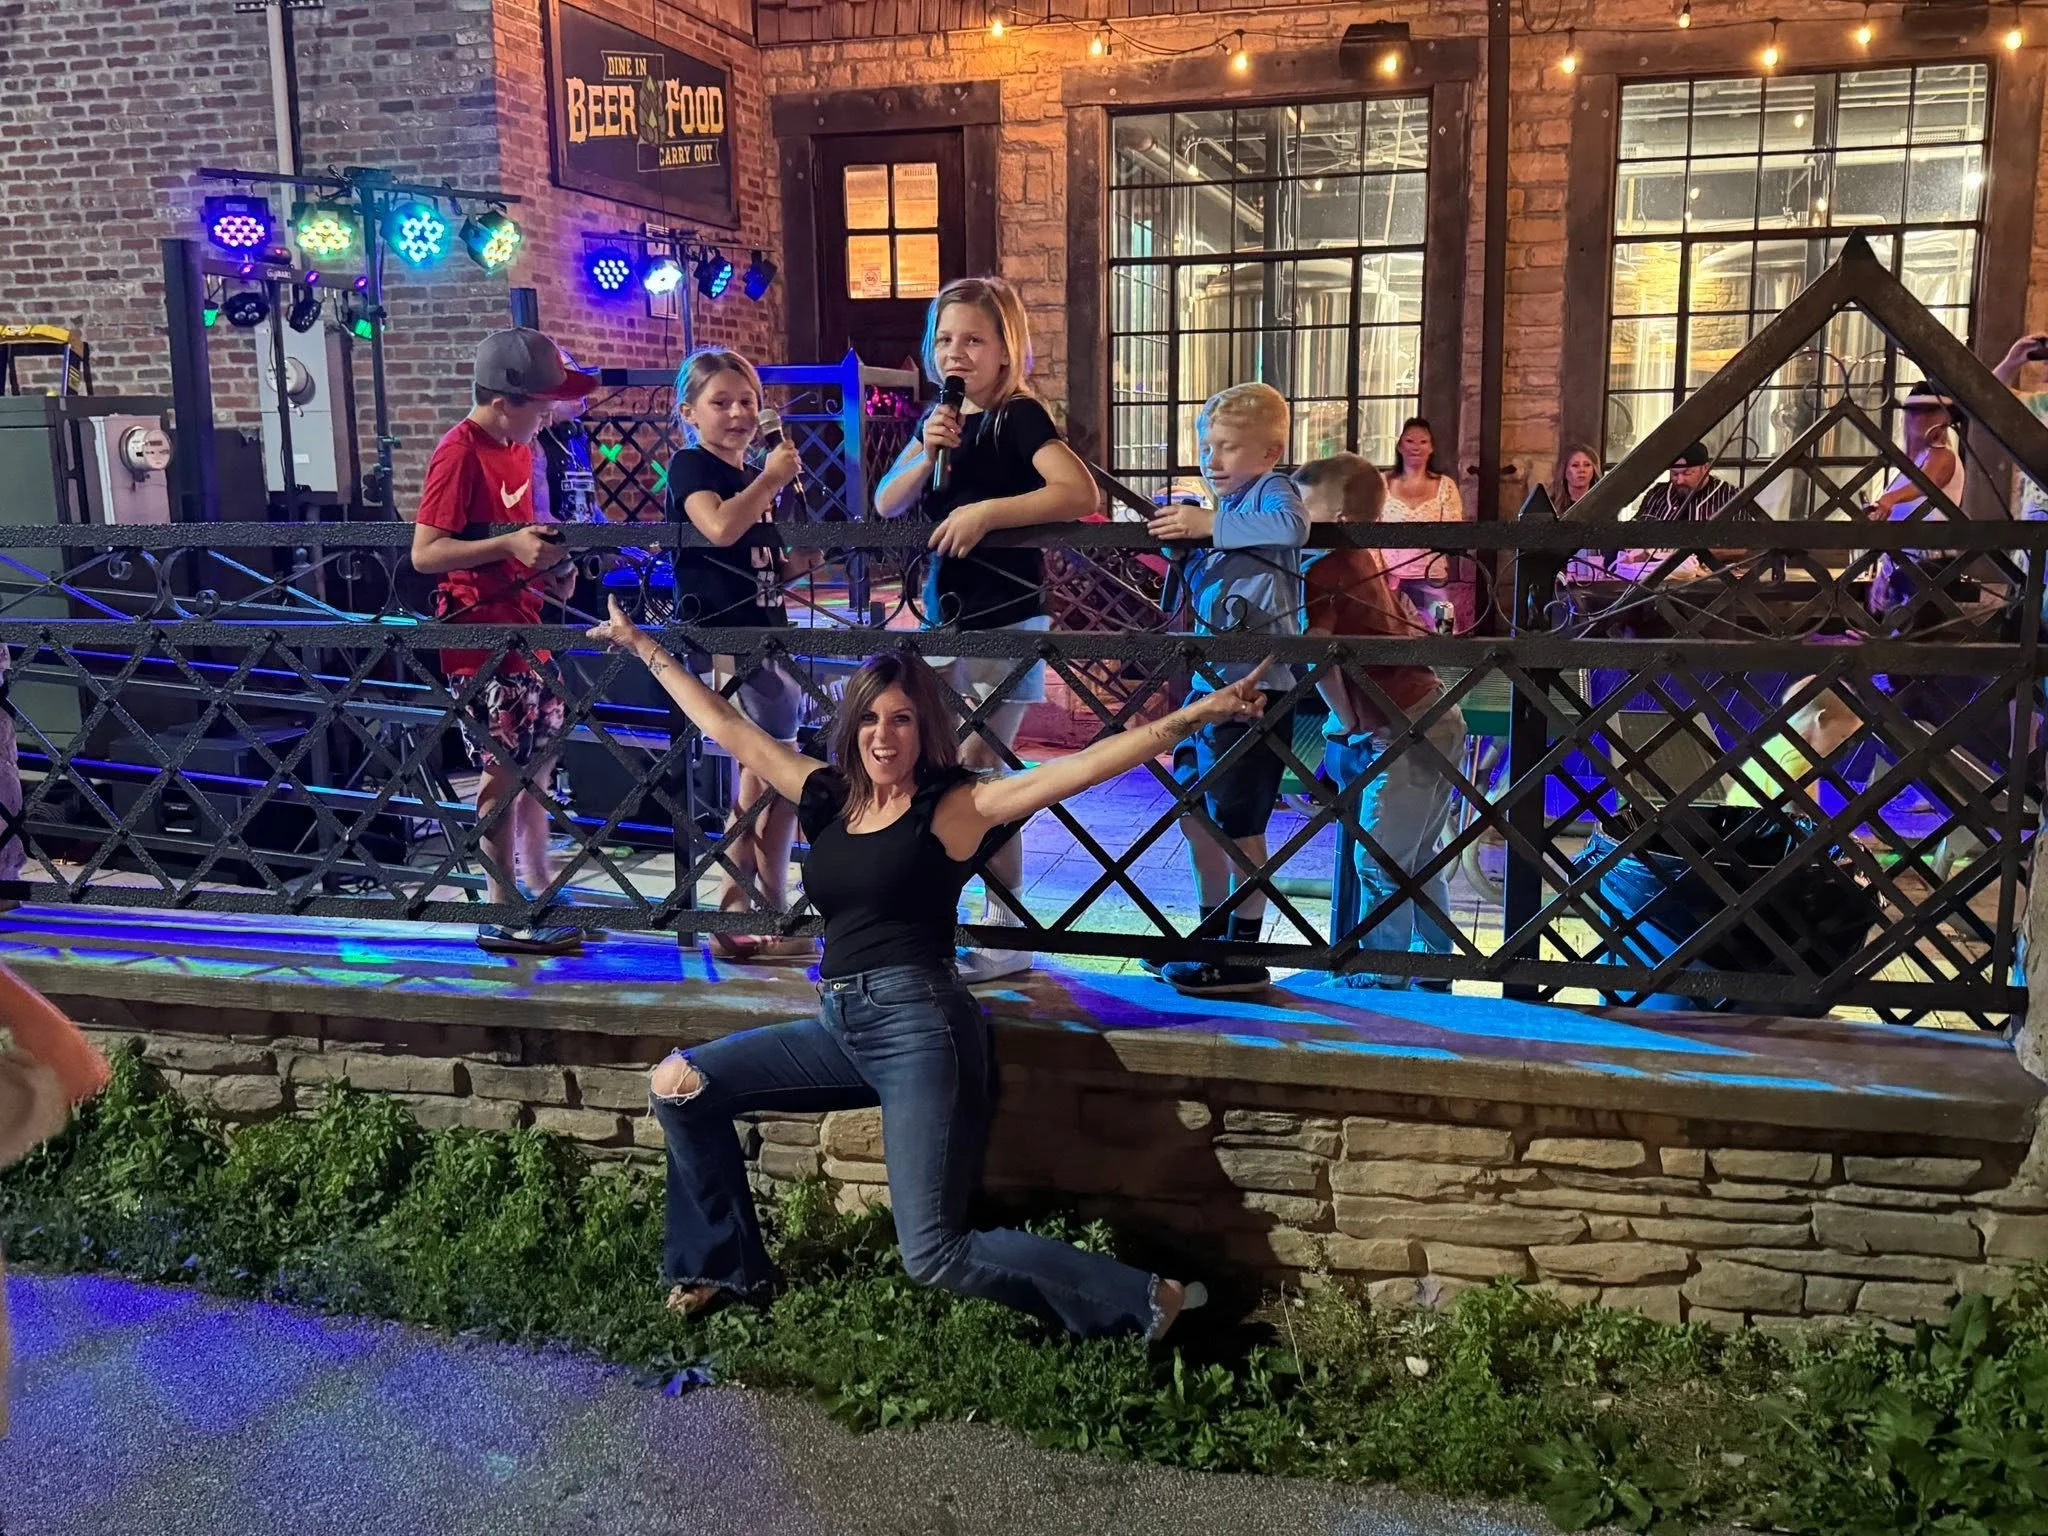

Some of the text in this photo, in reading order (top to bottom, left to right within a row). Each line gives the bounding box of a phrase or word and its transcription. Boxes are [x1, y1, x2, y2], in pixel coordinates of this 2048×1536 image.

[608, 57, 647, 76] DINE IN
[566, 77, 724, 143] BEER FOOD
[659, 145, 713, 166] CARRY OUT
